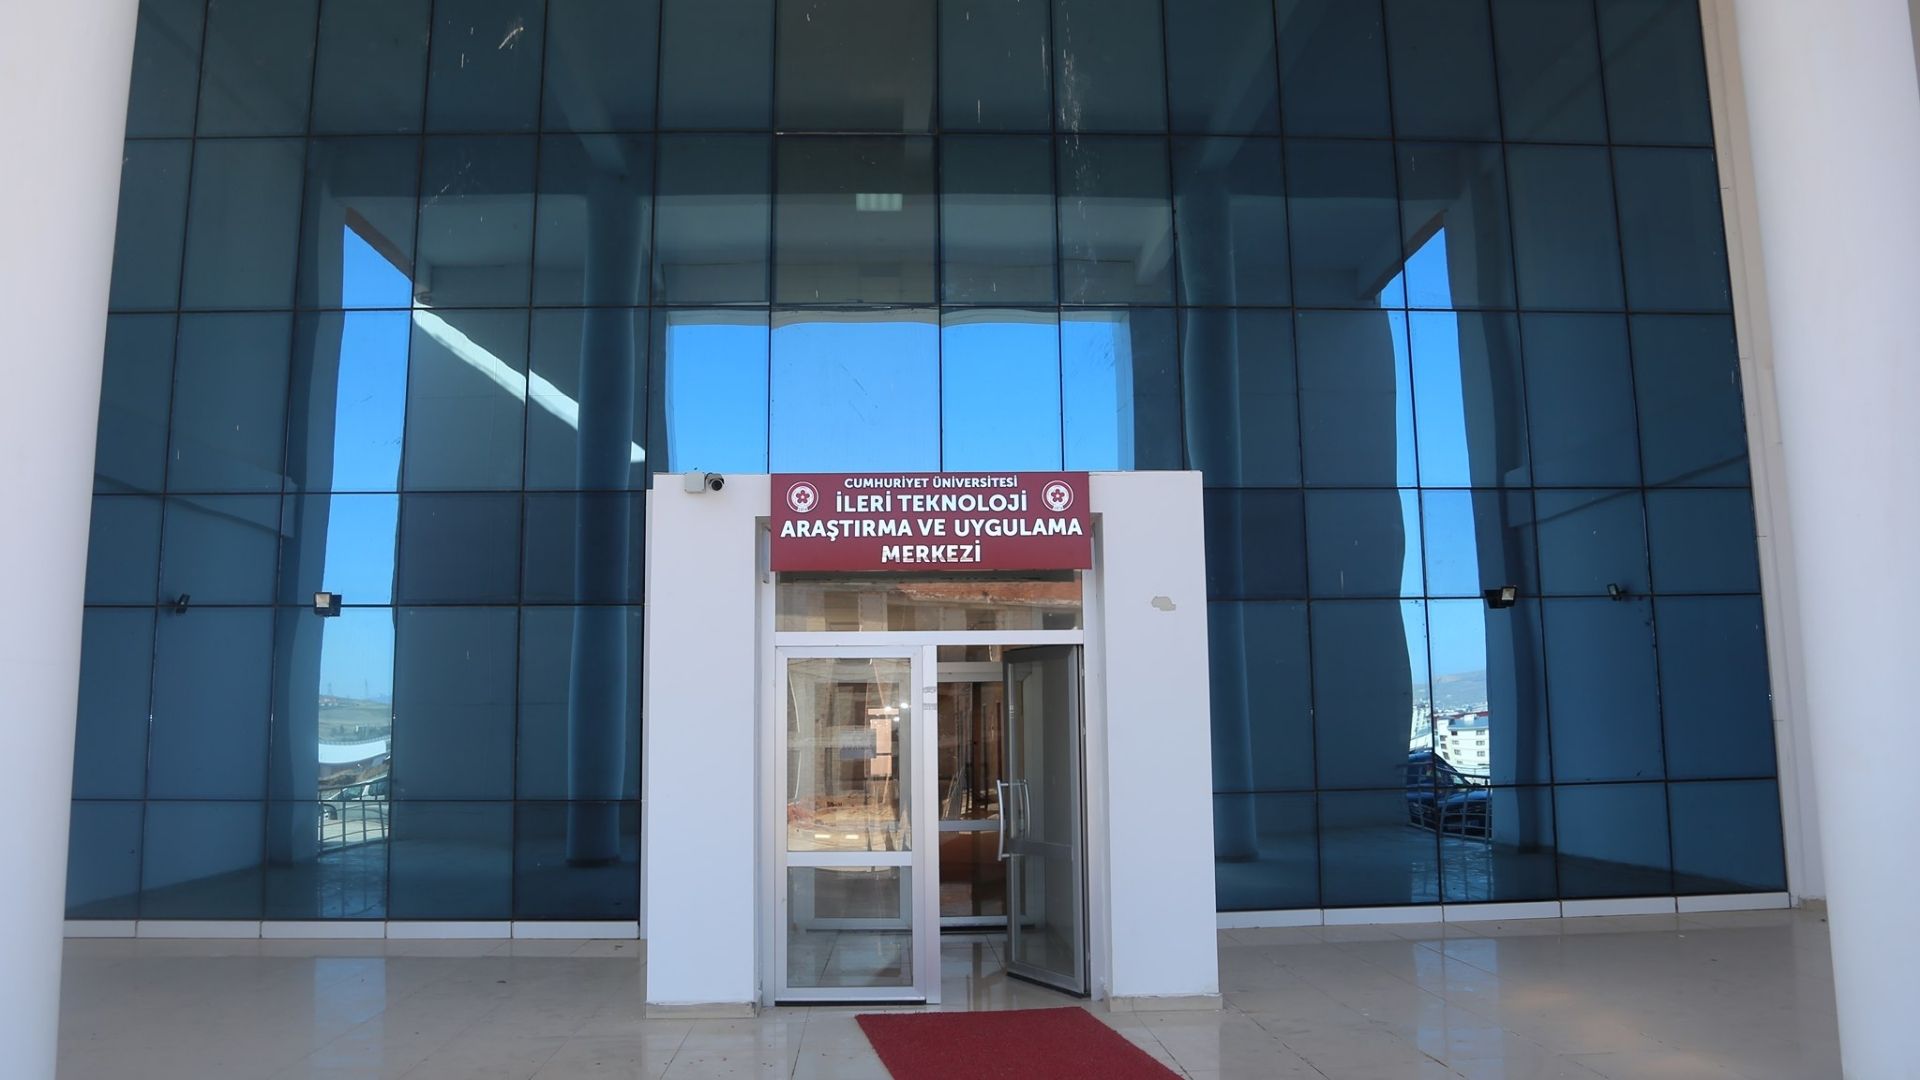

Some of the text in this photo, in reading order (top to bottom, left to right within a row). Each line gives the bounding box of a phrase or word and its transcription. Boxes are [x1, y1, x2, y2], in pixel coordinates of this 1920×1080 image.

[844, 475, 1017, 488] CUMHURİYET ÜNİVERSİTESİ
[837, 490, 1027, 512] İLERİ TEKNOLOJİ
[780, 517, 1083, 541] ARAŞTIRMA VE UYGULAMA
[881, 540, 981, 563] MERKEZİ
